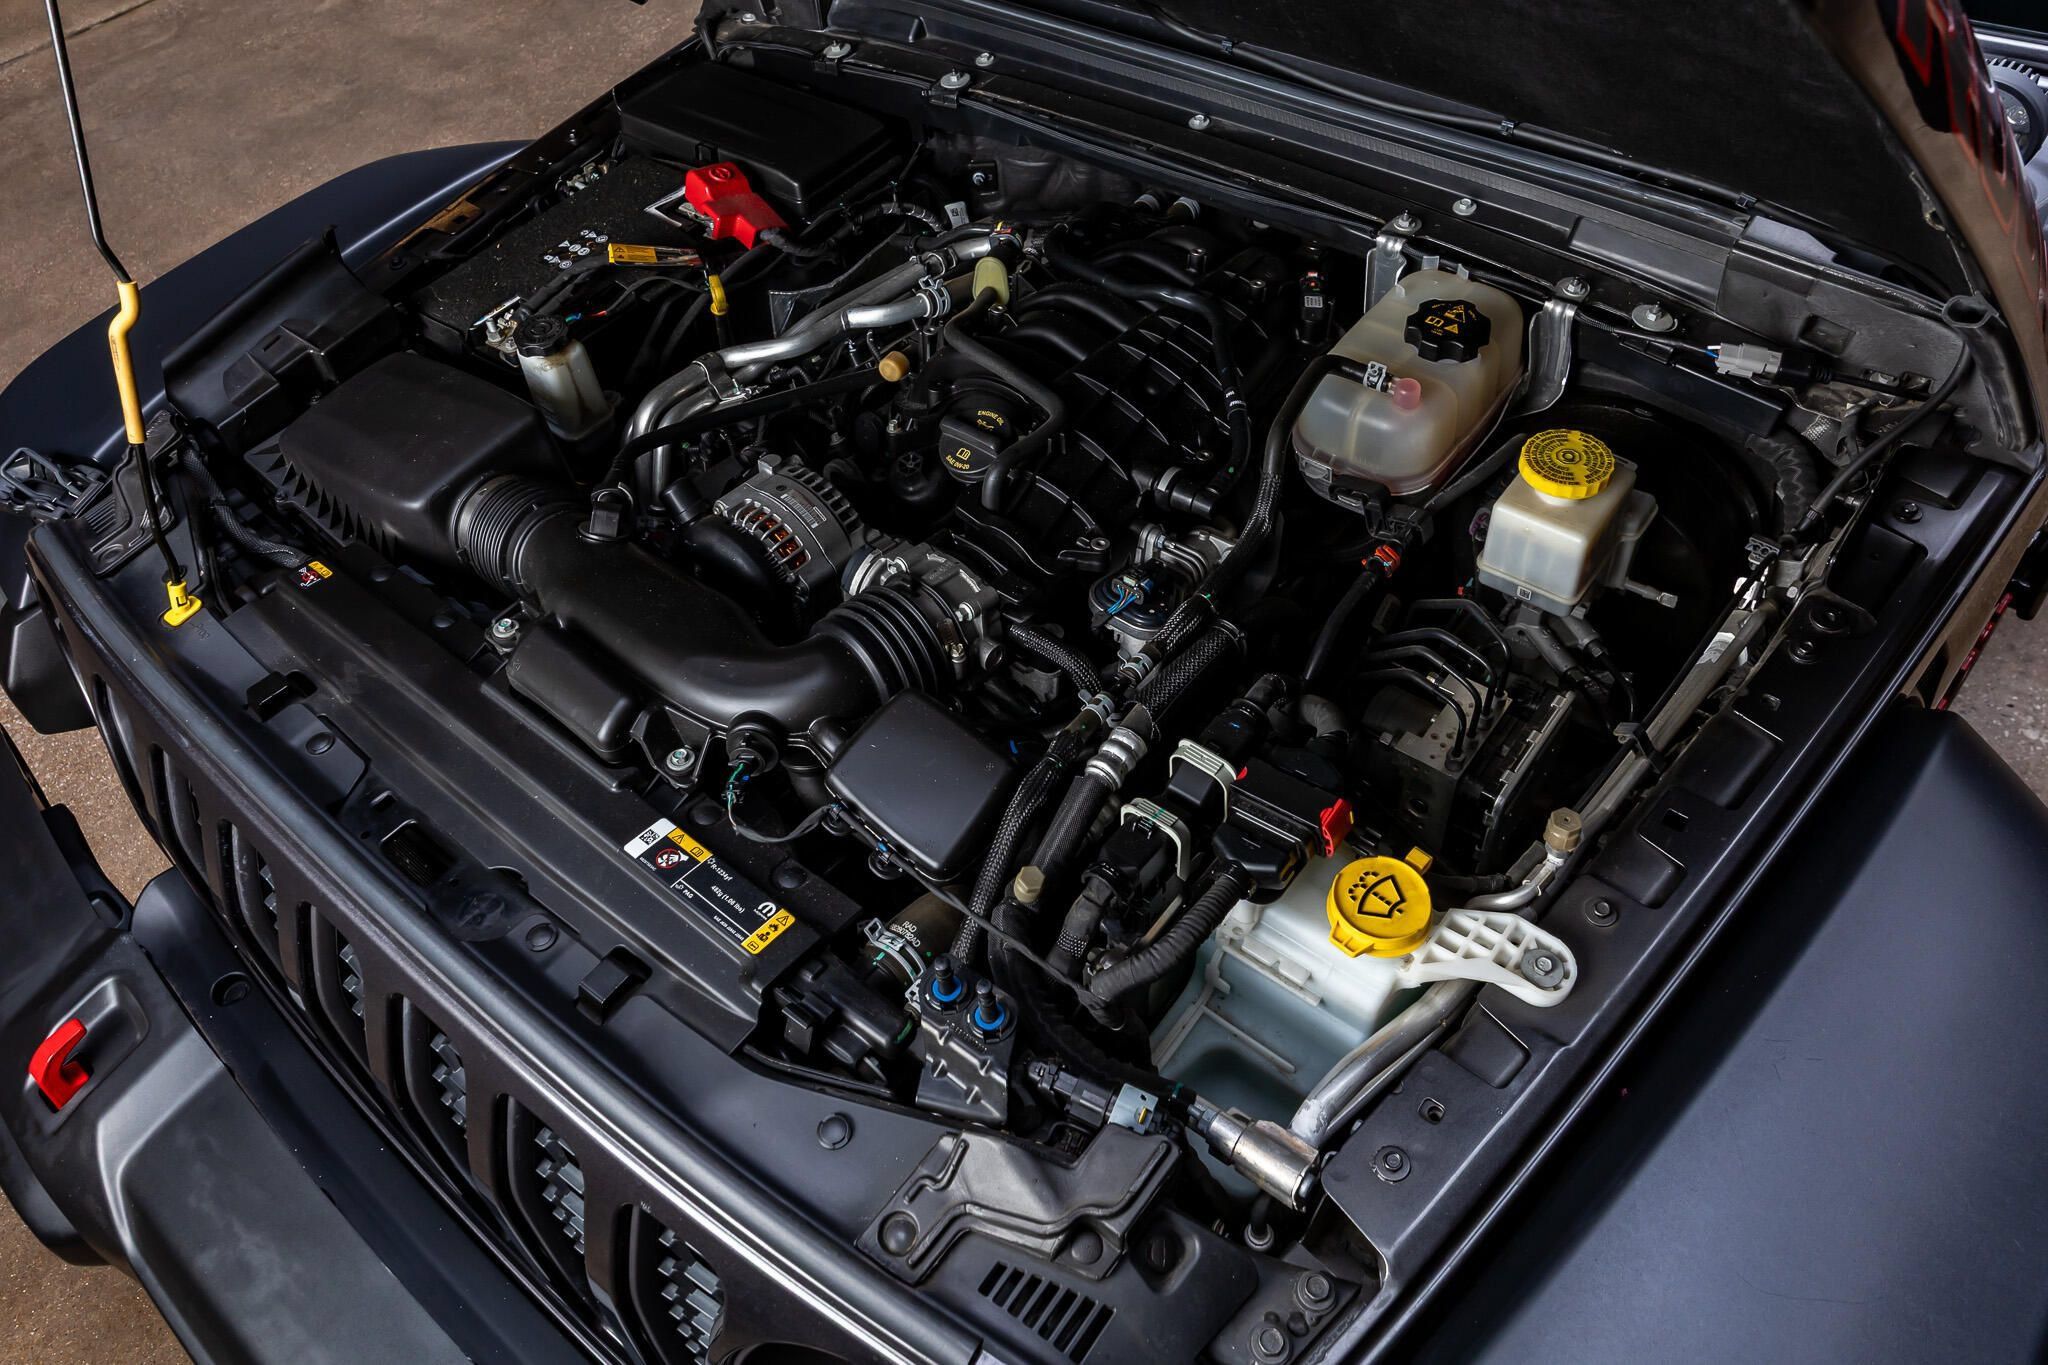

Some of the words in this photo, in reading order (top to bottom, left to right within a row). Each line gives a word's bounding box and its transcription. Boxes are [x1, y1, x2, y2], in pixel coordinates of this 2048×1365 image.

[978, 410, 998, 420] ENGINE
[945, 454, 955, 465] SAE
[710, 864, 733, 882] R-1234yf
[683, 888, 694, 899] PAG
[902, 920, 917, 932] RAD
